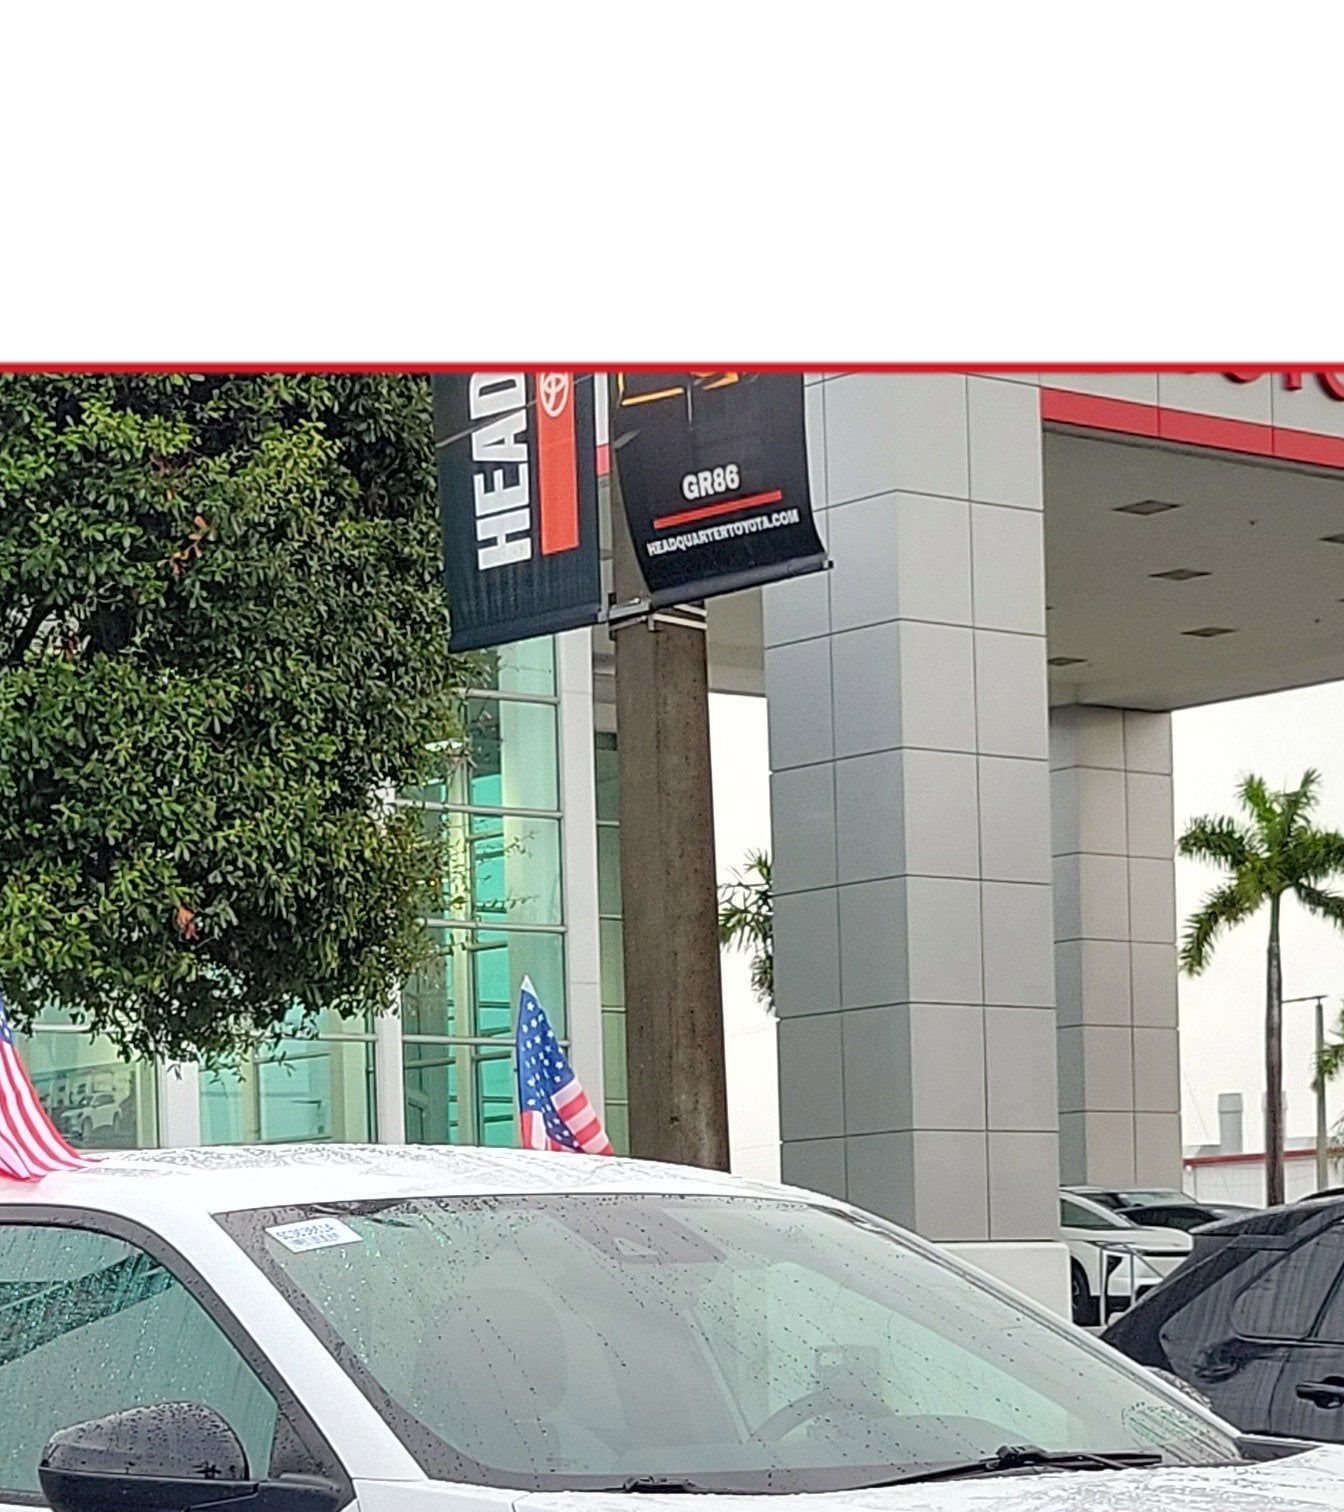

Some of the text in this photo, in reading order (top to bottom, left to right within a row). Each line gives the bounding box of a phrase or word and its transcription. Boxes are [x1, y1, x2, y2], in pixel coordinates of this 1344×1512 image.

[469, 372, 532, 571] HEAD
[682, 464, 740, 500] GR86
[646, 508, 800, 557] HEADQUARTERTOYOTA.COM
